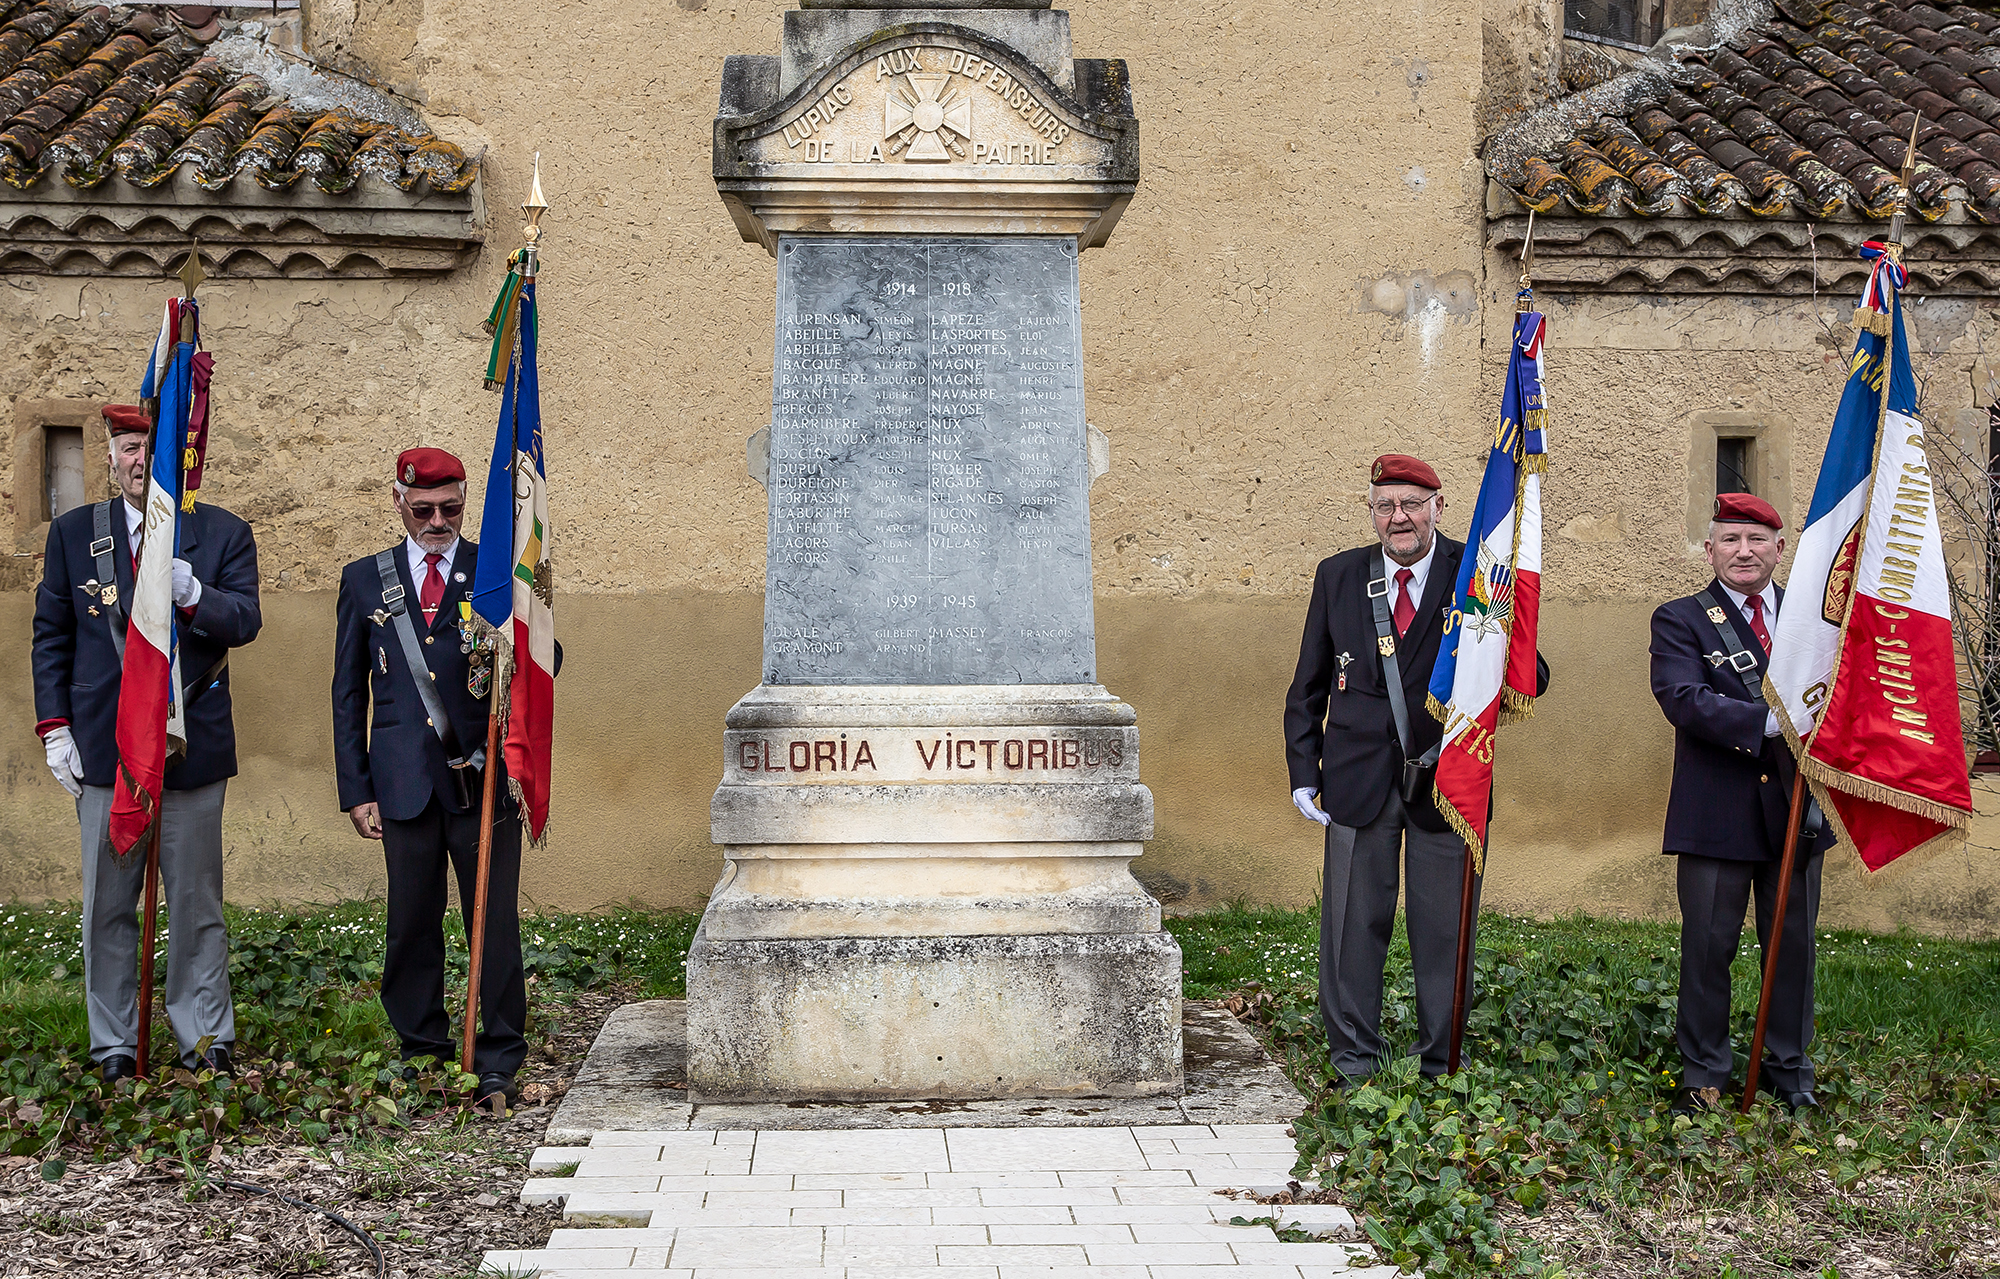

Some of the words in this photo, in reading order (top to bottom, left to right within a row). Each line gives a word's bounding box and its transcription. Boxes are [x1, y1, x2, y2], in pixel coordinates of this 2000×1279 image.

[781, 84, 853, 149] LUPIAC
[876, 47, 923, 82] AUX
[948, 50, 1070, 145] DEFENSEURS
[805, 139, 833, 163] DE
[851, 140, 885, 163] LA
[973, 141, 1056, 165] PATRIE
[886, 283, 916, 295] 1914
[942, 283, 971, 295] 1918
[786, 314, 861, 325] AURENSAN
[875, 316, 914, 325] SIMEON
[931, 314, 983, 325] LAPEZE
[784, 329, 840, 340] ABEILLE
[874, 332, 913, 340] ALEXIS
[932, 330, 1007, 340] LASPORTES
[1020, 332, 1042, 340] ELOI
[784, 344, 841, 354] ABEILLE
[874, 346, 911, 354] JOSEPH
[932, 344, 1007, 355] LASPORTES
[1020, 347, 1048, 355] JEAN
[784, 359, 842, 370] BACQUE
[875, 361, 917, 370] ALFRED
[931, 359, 983, 370] MAGNE
[1020, 362, 1068, 370] AUGUSTE
[1020, 377, 1054, 385] HENRI
[783, 389, 839, 399] BRANET
[931, 389, 997, 399] NAVARRE
[1020, 392, 1062, 400] MARIUS
[782, 404, 832, 414] BERGES
[875, 406, 911, 414] JOSEPH
[931, 404, 984, 415] NAYOSE
[1019, 406, 1048, 415] JEAN
[875, 421, 927, 429] FREDERIC
[931, 419, 961, 429] NUX
[931, 434, 961, 445] NUX
[780, 448, 830, 459] DUCLOS
[931, 450, 961, 461] NUX
[1020, 452, 1049, 461] OMER
[1020, 466, 1056, 475] JOSEPH
[779, 478, 850, 488] DUREIGNE
[932, 477, 983, 488] RIGADE
[778, 493, 850, 503] FORTASSIN
[1020, 496, 1057, 505] JOSEPH
[778, 508, 851, 518] LABURTHE
[1019, 511, 1045, 519] PAUL
[777, 523, 843, 533] LAFFITTE
[932, 523, 987, 533] TURSAN
[777, 538, 829, 548] LAGORS
[776, 552, 829, 563] LAGORS
[887, 595, 917, 608] 1939
[943, 595, 976, 608] 1945
[875, 629, 919, 638] GILBERT
[931, 627, 986, 638] MASSEY
[773, 642, 843, 653] GRAMONT
[876, 644, 925, 653] ARMAND
[739, 732, 878, 773] GLORIA
[915, 732, 1124, 771] VICTORIBUS
